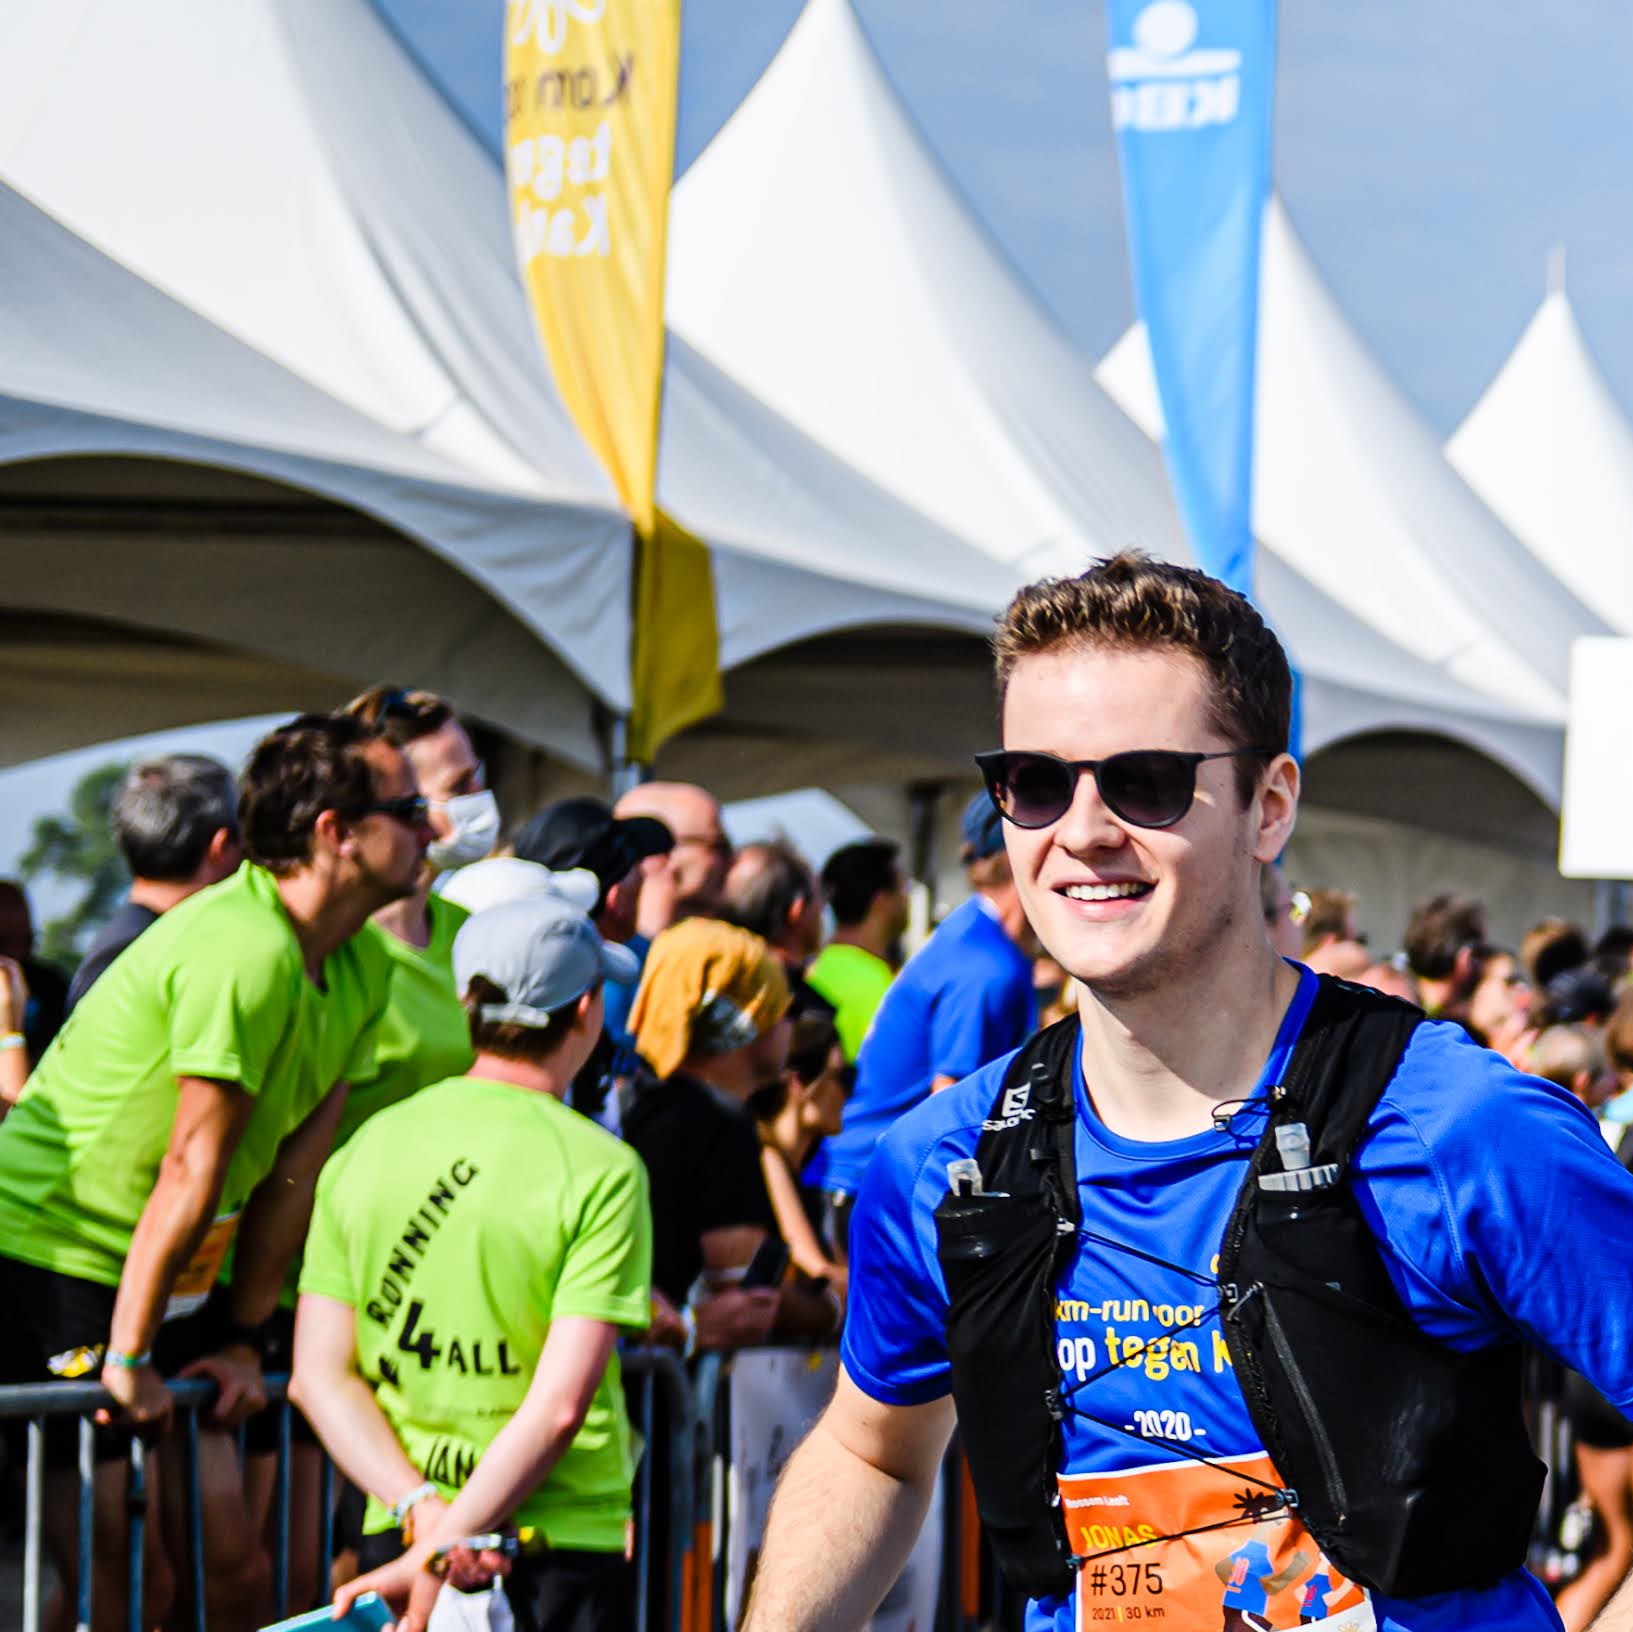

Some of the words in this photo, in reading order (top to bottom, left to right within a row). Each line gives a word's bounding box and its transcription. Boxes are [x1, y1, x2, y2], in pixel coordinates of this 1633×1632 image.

[366, 1157, 479, 1329] RUNNING
[1058, 1337, 1096, 1382] op
[1105, 1327, 1200, 1380] tegen
[1080, 1524, 1158, 1549] JONAS
[1091, 1563, 1163, 1596] #375
[1092, 1607, 1115, 1620] 2021
[1126, 1606, 1141, 1619] 30
[1145, 1605, 1165, 1618] km
